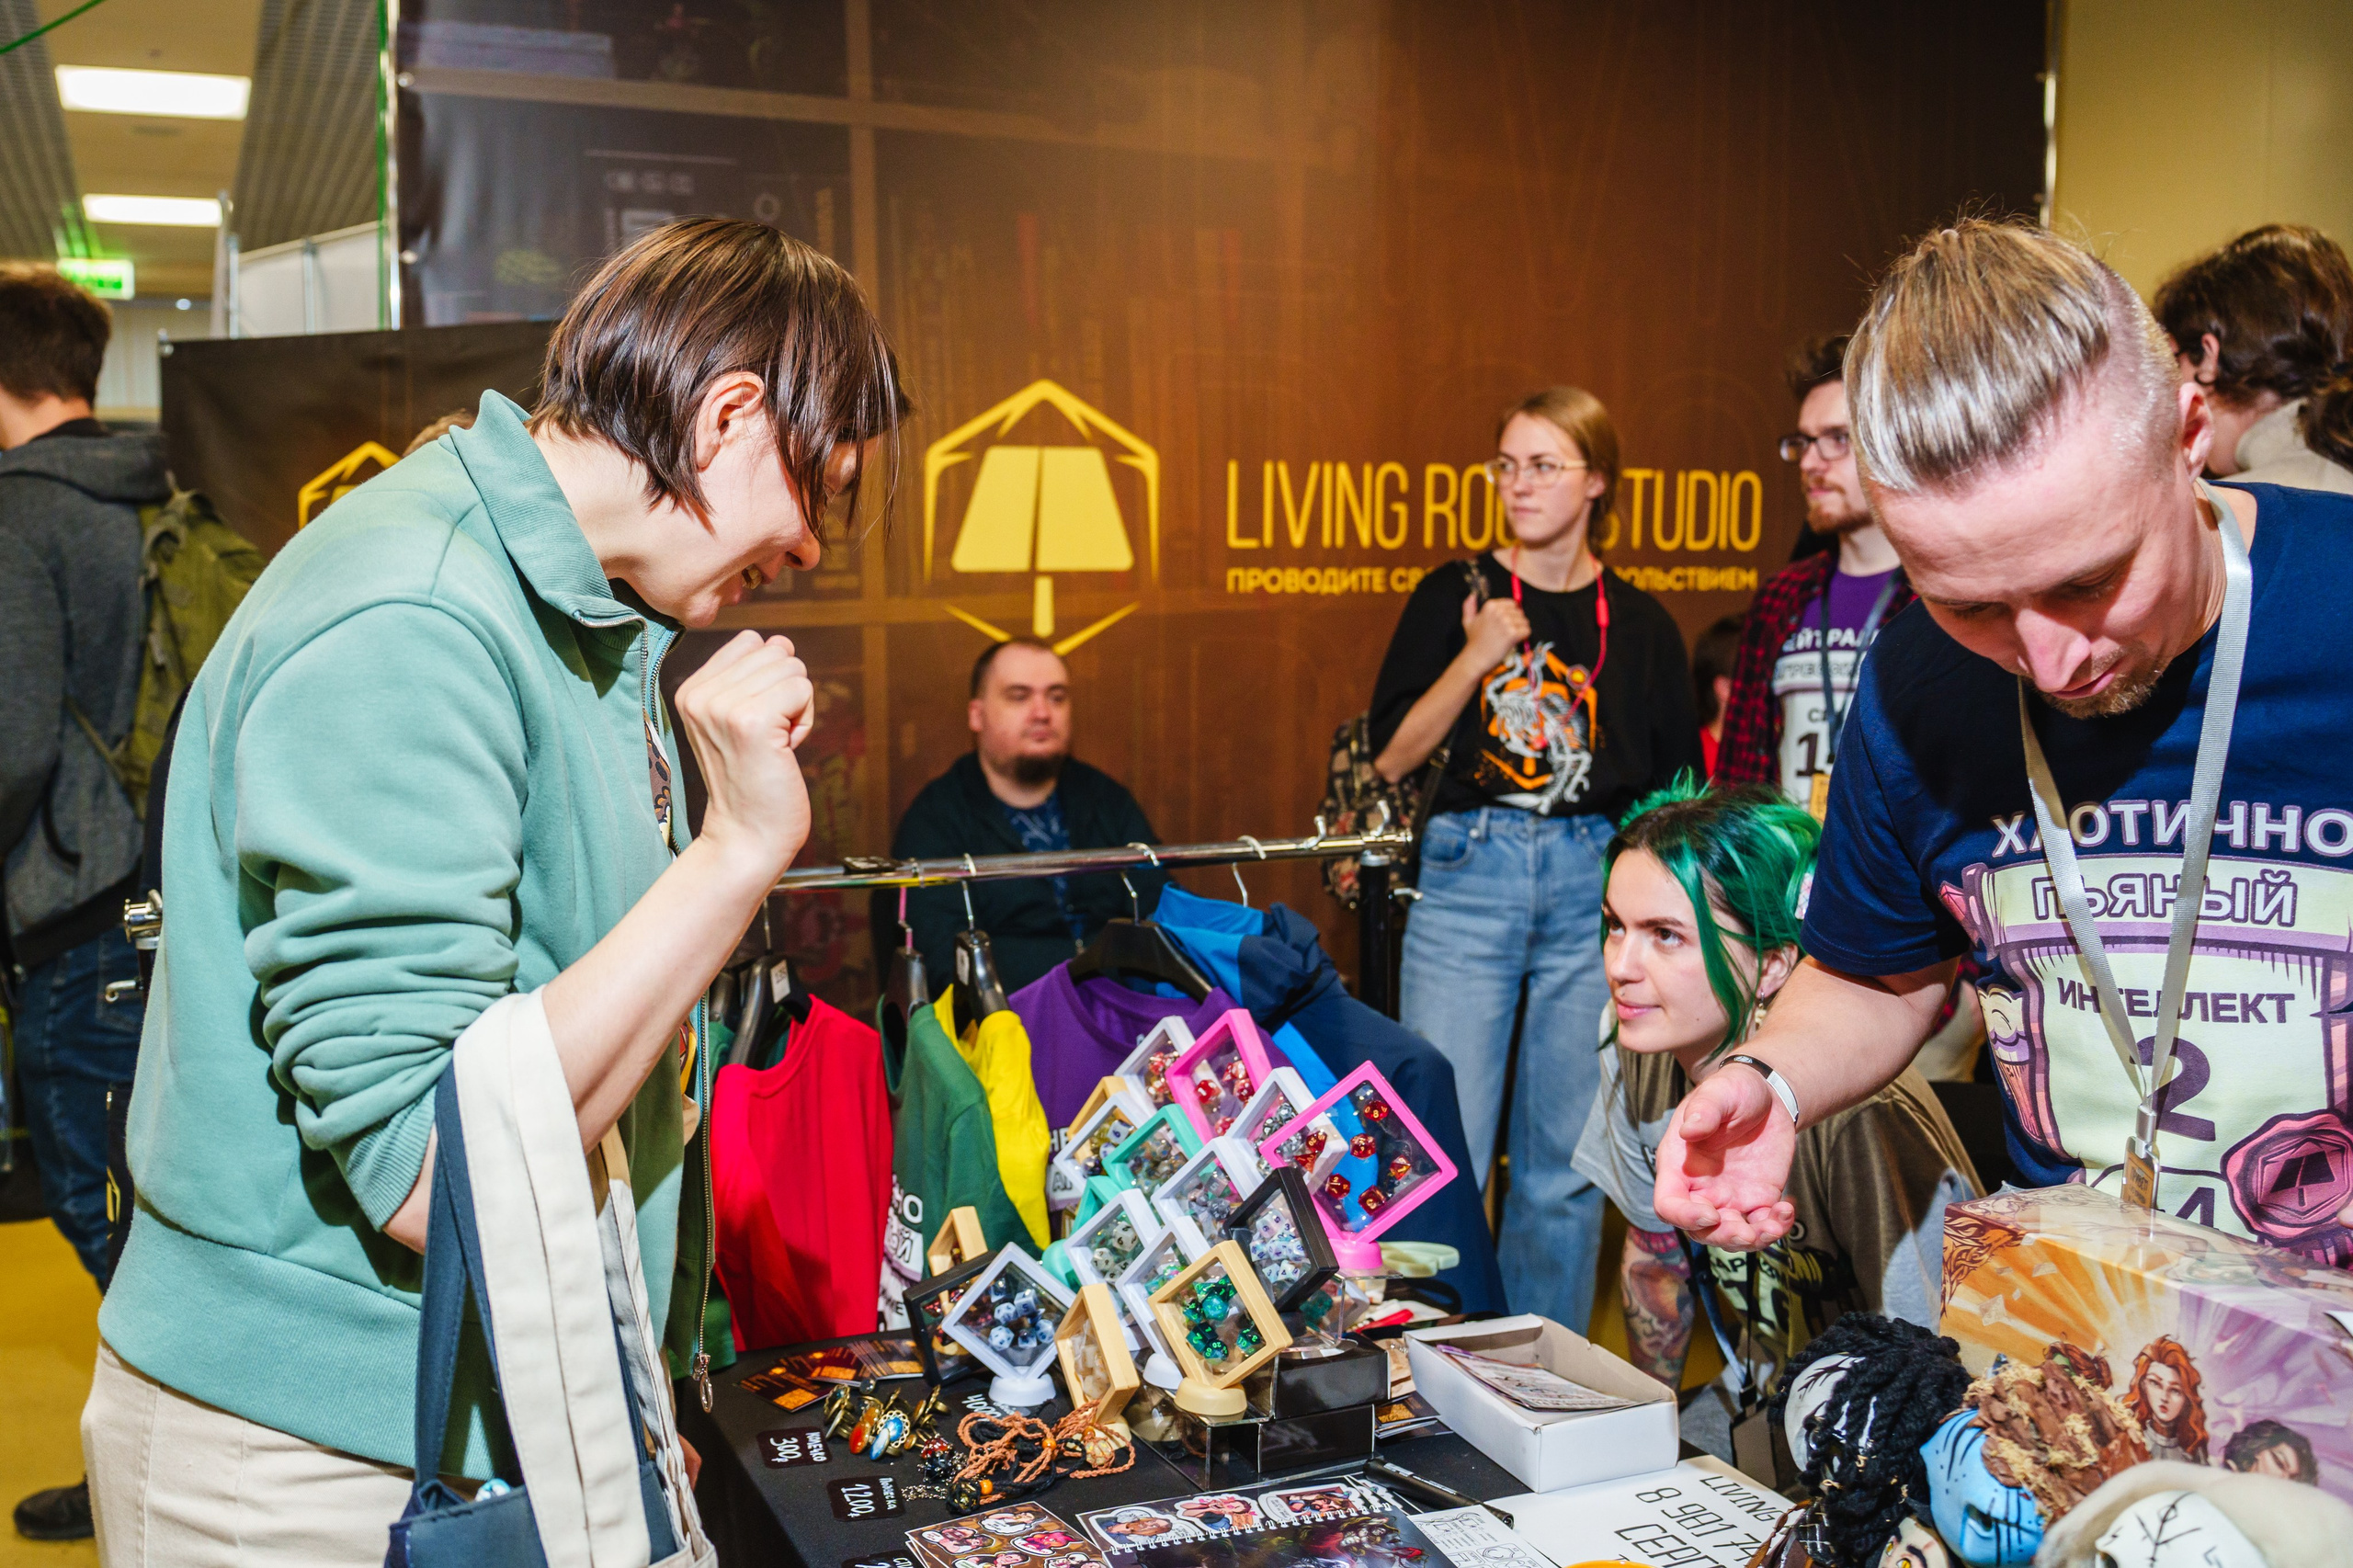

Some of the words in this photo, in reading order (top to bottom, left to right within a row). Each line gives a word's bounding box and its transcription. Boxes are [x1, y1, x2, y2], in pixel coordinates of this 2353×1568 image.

[1226, 459, 1409, 551] LIVING
[1424, 462, 1519, 551] RO
[1226, 566, 1387, 595] ПРОВОДИТЕ
[1612, 565, 1758, 592] ОЛЬСТВИЕМ
[1991, 799, 2353, 859] ХОТИЧНО
[2057, 976, 2296, 1024] ИНЕЛЕКТ
[2129, 1034, 2217, 1142] 2
[1634, 1486, 1683, 1504] 8
[1699, 1474, 1785, 1523] LIVING
[1613, 1523, 1727, 1568] СЕРГ
